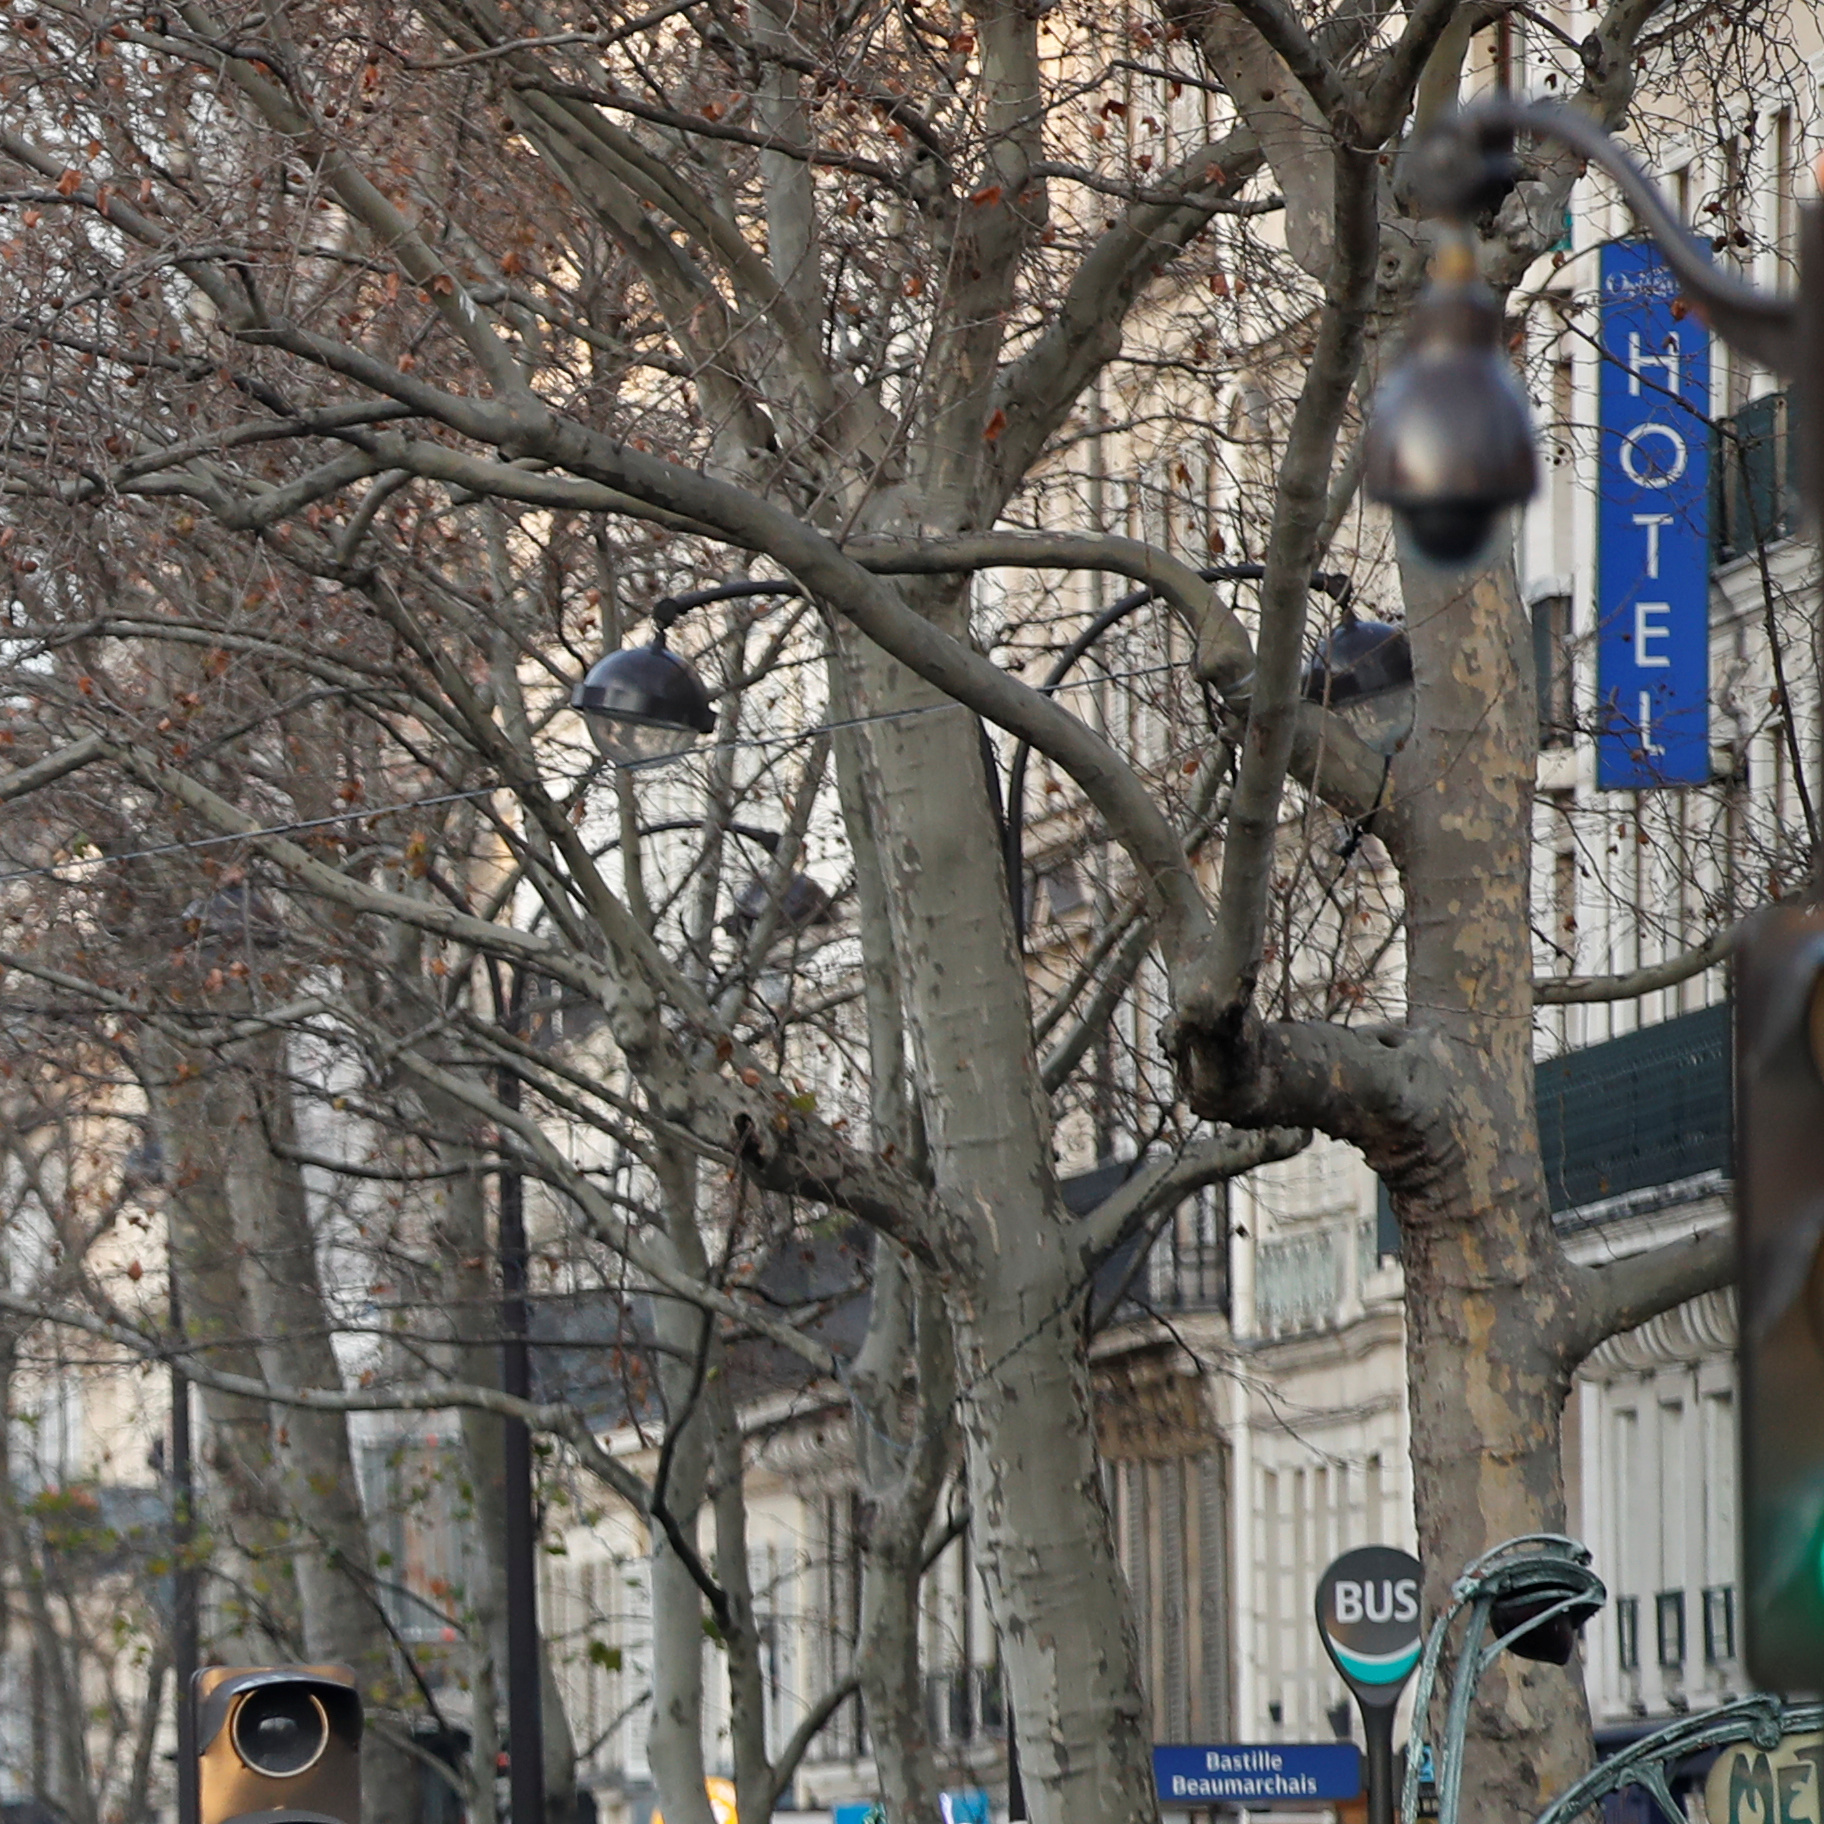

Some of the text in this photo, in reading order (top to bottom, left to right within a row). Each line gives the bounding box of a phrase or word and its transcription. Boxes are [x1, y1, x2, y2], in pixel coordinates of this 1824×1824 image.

[1618, 330, 1689, 757] HOTEL
[1334, 1579, 1420, 1625] BUS
[1205, 1750, 1283, 1773] Bastille
[1171, 1774, 1319, 1797] Beaumarchais
